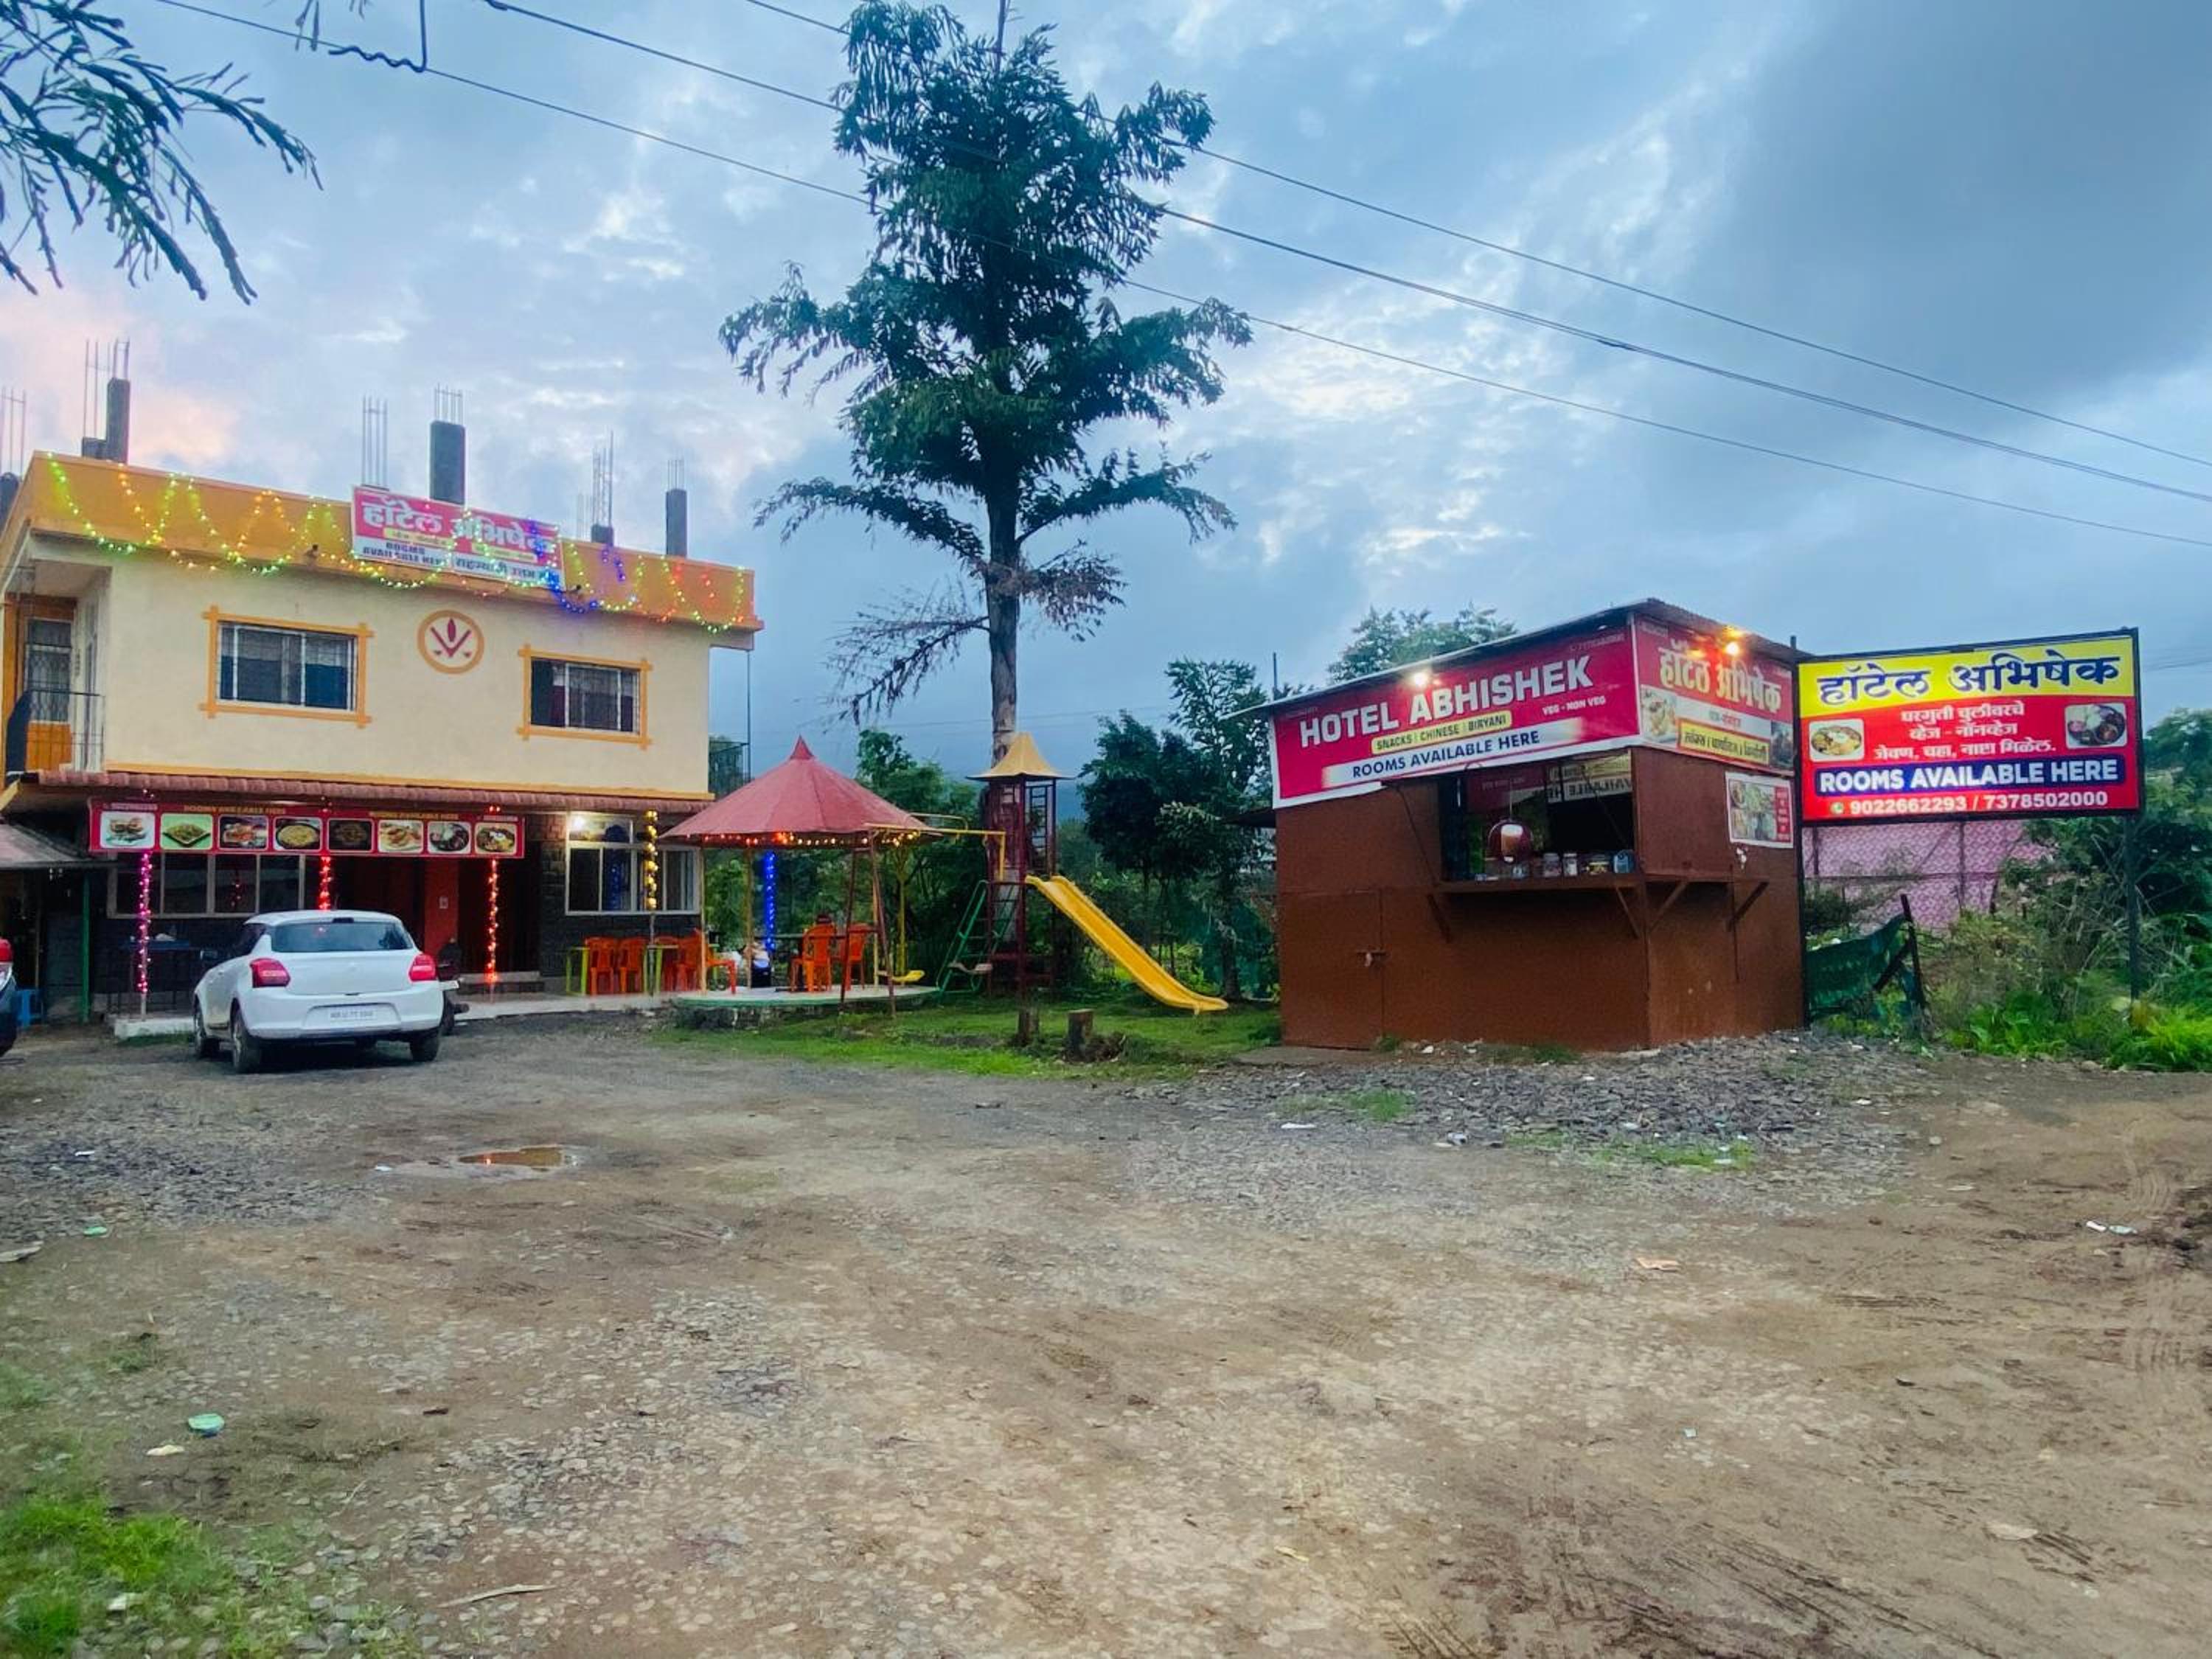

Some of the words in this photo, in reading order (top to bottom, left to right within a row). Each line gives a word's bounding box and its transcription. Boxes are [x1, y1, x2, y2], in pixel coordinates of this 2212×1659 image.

[1658, 639, 1711, 693] हॉटेल
[1716, 661, 1781, 713] अभिषेक
[1818, 663, 1931, 704] हॉटेल
[1949, 650, 2120, 692] अभिषेक
[1300, 702, 1399, 748] HOTEL
[1409, 655, 1593, 724] ABHISHEK
[1542, 705, 1559, 715] VEG
[1568, 700, 1587, 711] NON
[1587, 695, 1605, 706] VEG
[1902, 705, 1953, 724] घरगुती
[1377, 736, 1411, 751] SNACKS
[1420, 726, 1459, 741] CHINESE
[1469, 715, 1506, 731] BIRYANI
[1353, 757, 1405, 779] ROOMS
[1411, 738, 1493, 765] AVAILABLE
[1498, 731, 1540, 749] HERE
[1820, 770, 1904, 793] ROOMS
[1910, 763, 2045, 789] AVAILABLE
[2051, 759, 2118, 782] HERE
[1851, 796, 1966, 815] 9022662293
[1983, 791, 2107, 810] 7378502000
